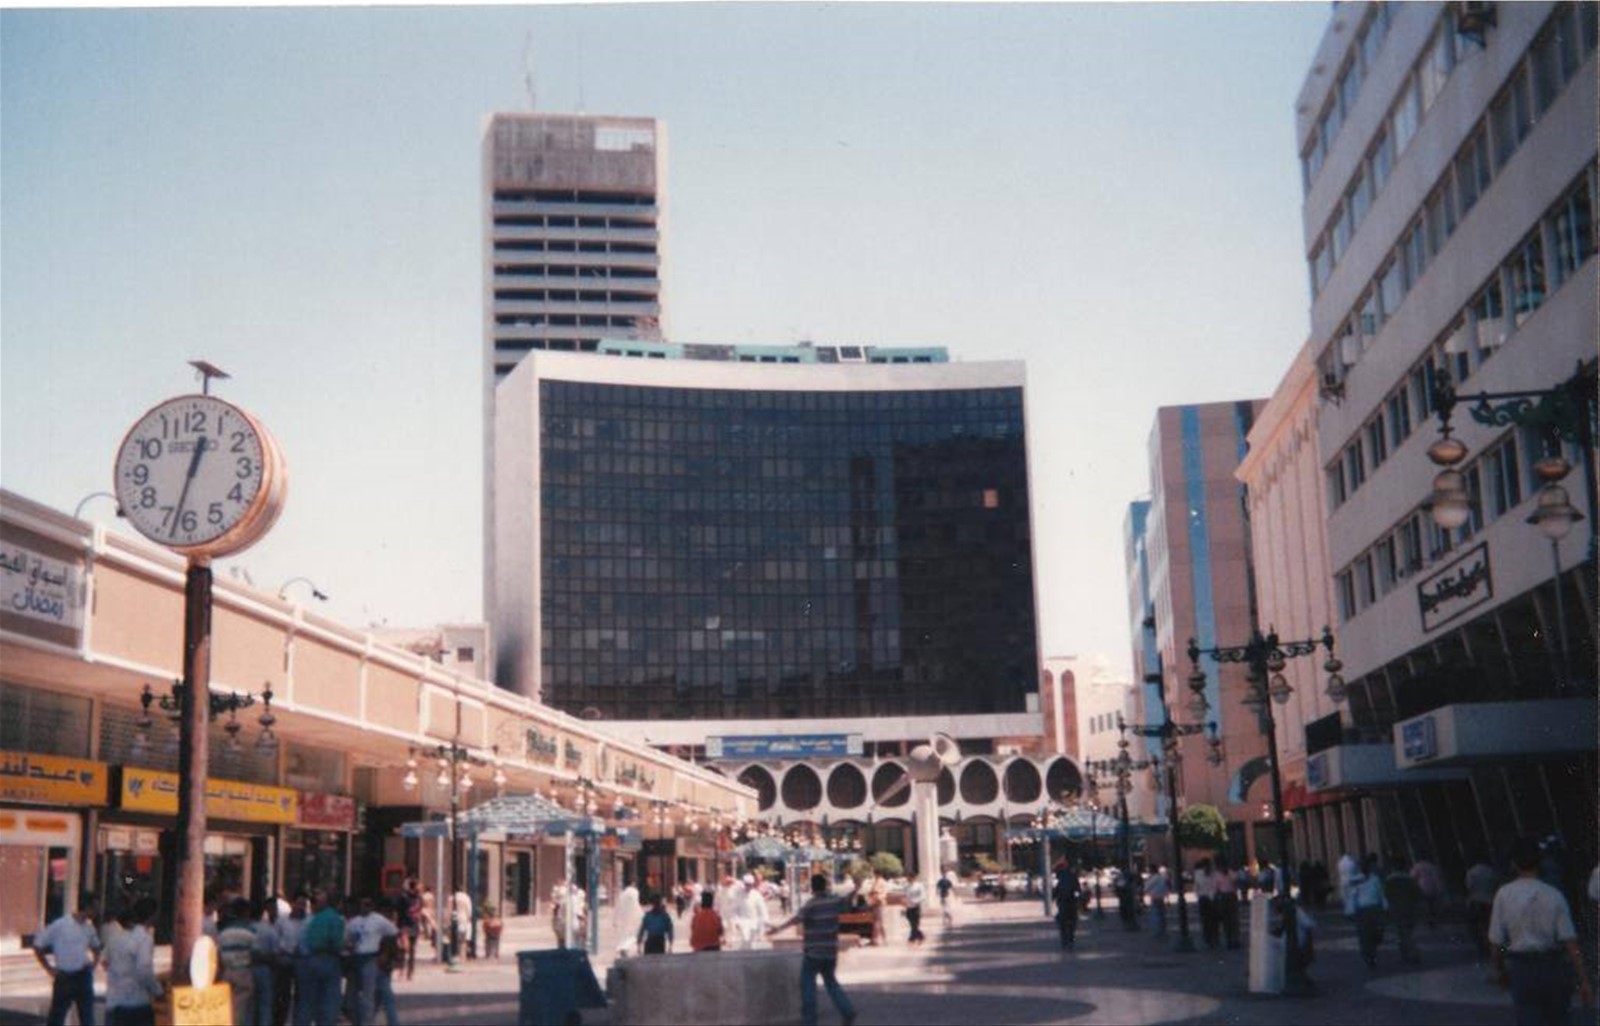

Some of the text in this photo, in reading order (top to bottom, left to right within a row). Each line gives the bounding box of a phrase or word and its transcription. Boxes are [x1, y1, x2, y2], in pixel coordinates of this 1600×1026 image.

[162, 417, 179, 439] 11
[185, 412, 206, 432] 12
[139, 438, 162, 459] 10
[230, 432, 246, 453] 2
[132, 464, 149, 485] 9
[236, 457, 252, 479] 3
[140, 487, 156, 509] 8
[227, 483, 243, 504] 4
[159, 506, 175, 527] 7
[181, 510, 198, 532] 6
[207, 503, 224, 524] 5
